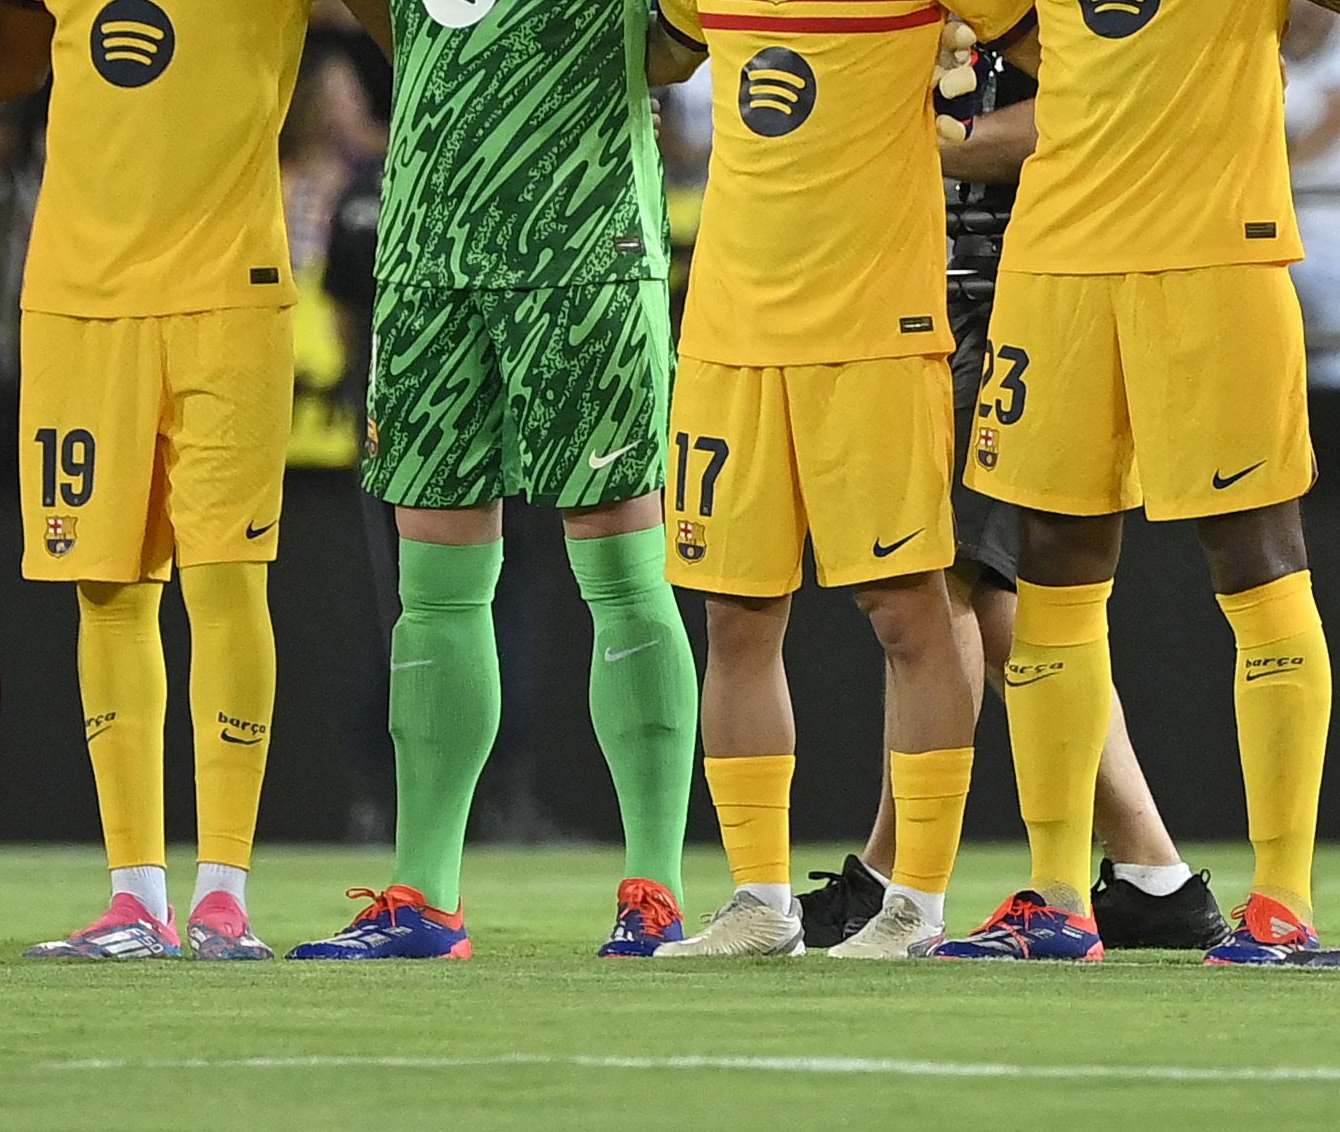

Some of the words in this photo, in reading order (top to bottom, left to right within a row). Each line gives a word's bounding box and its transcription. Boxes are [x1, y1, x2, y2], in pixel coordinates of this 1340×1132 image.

[33, 428, 97, 508] 19
[675, 431, 730, 518] 17
[1244, 656, 1305, 670] barça
[217, 712, 267, 736] barça
